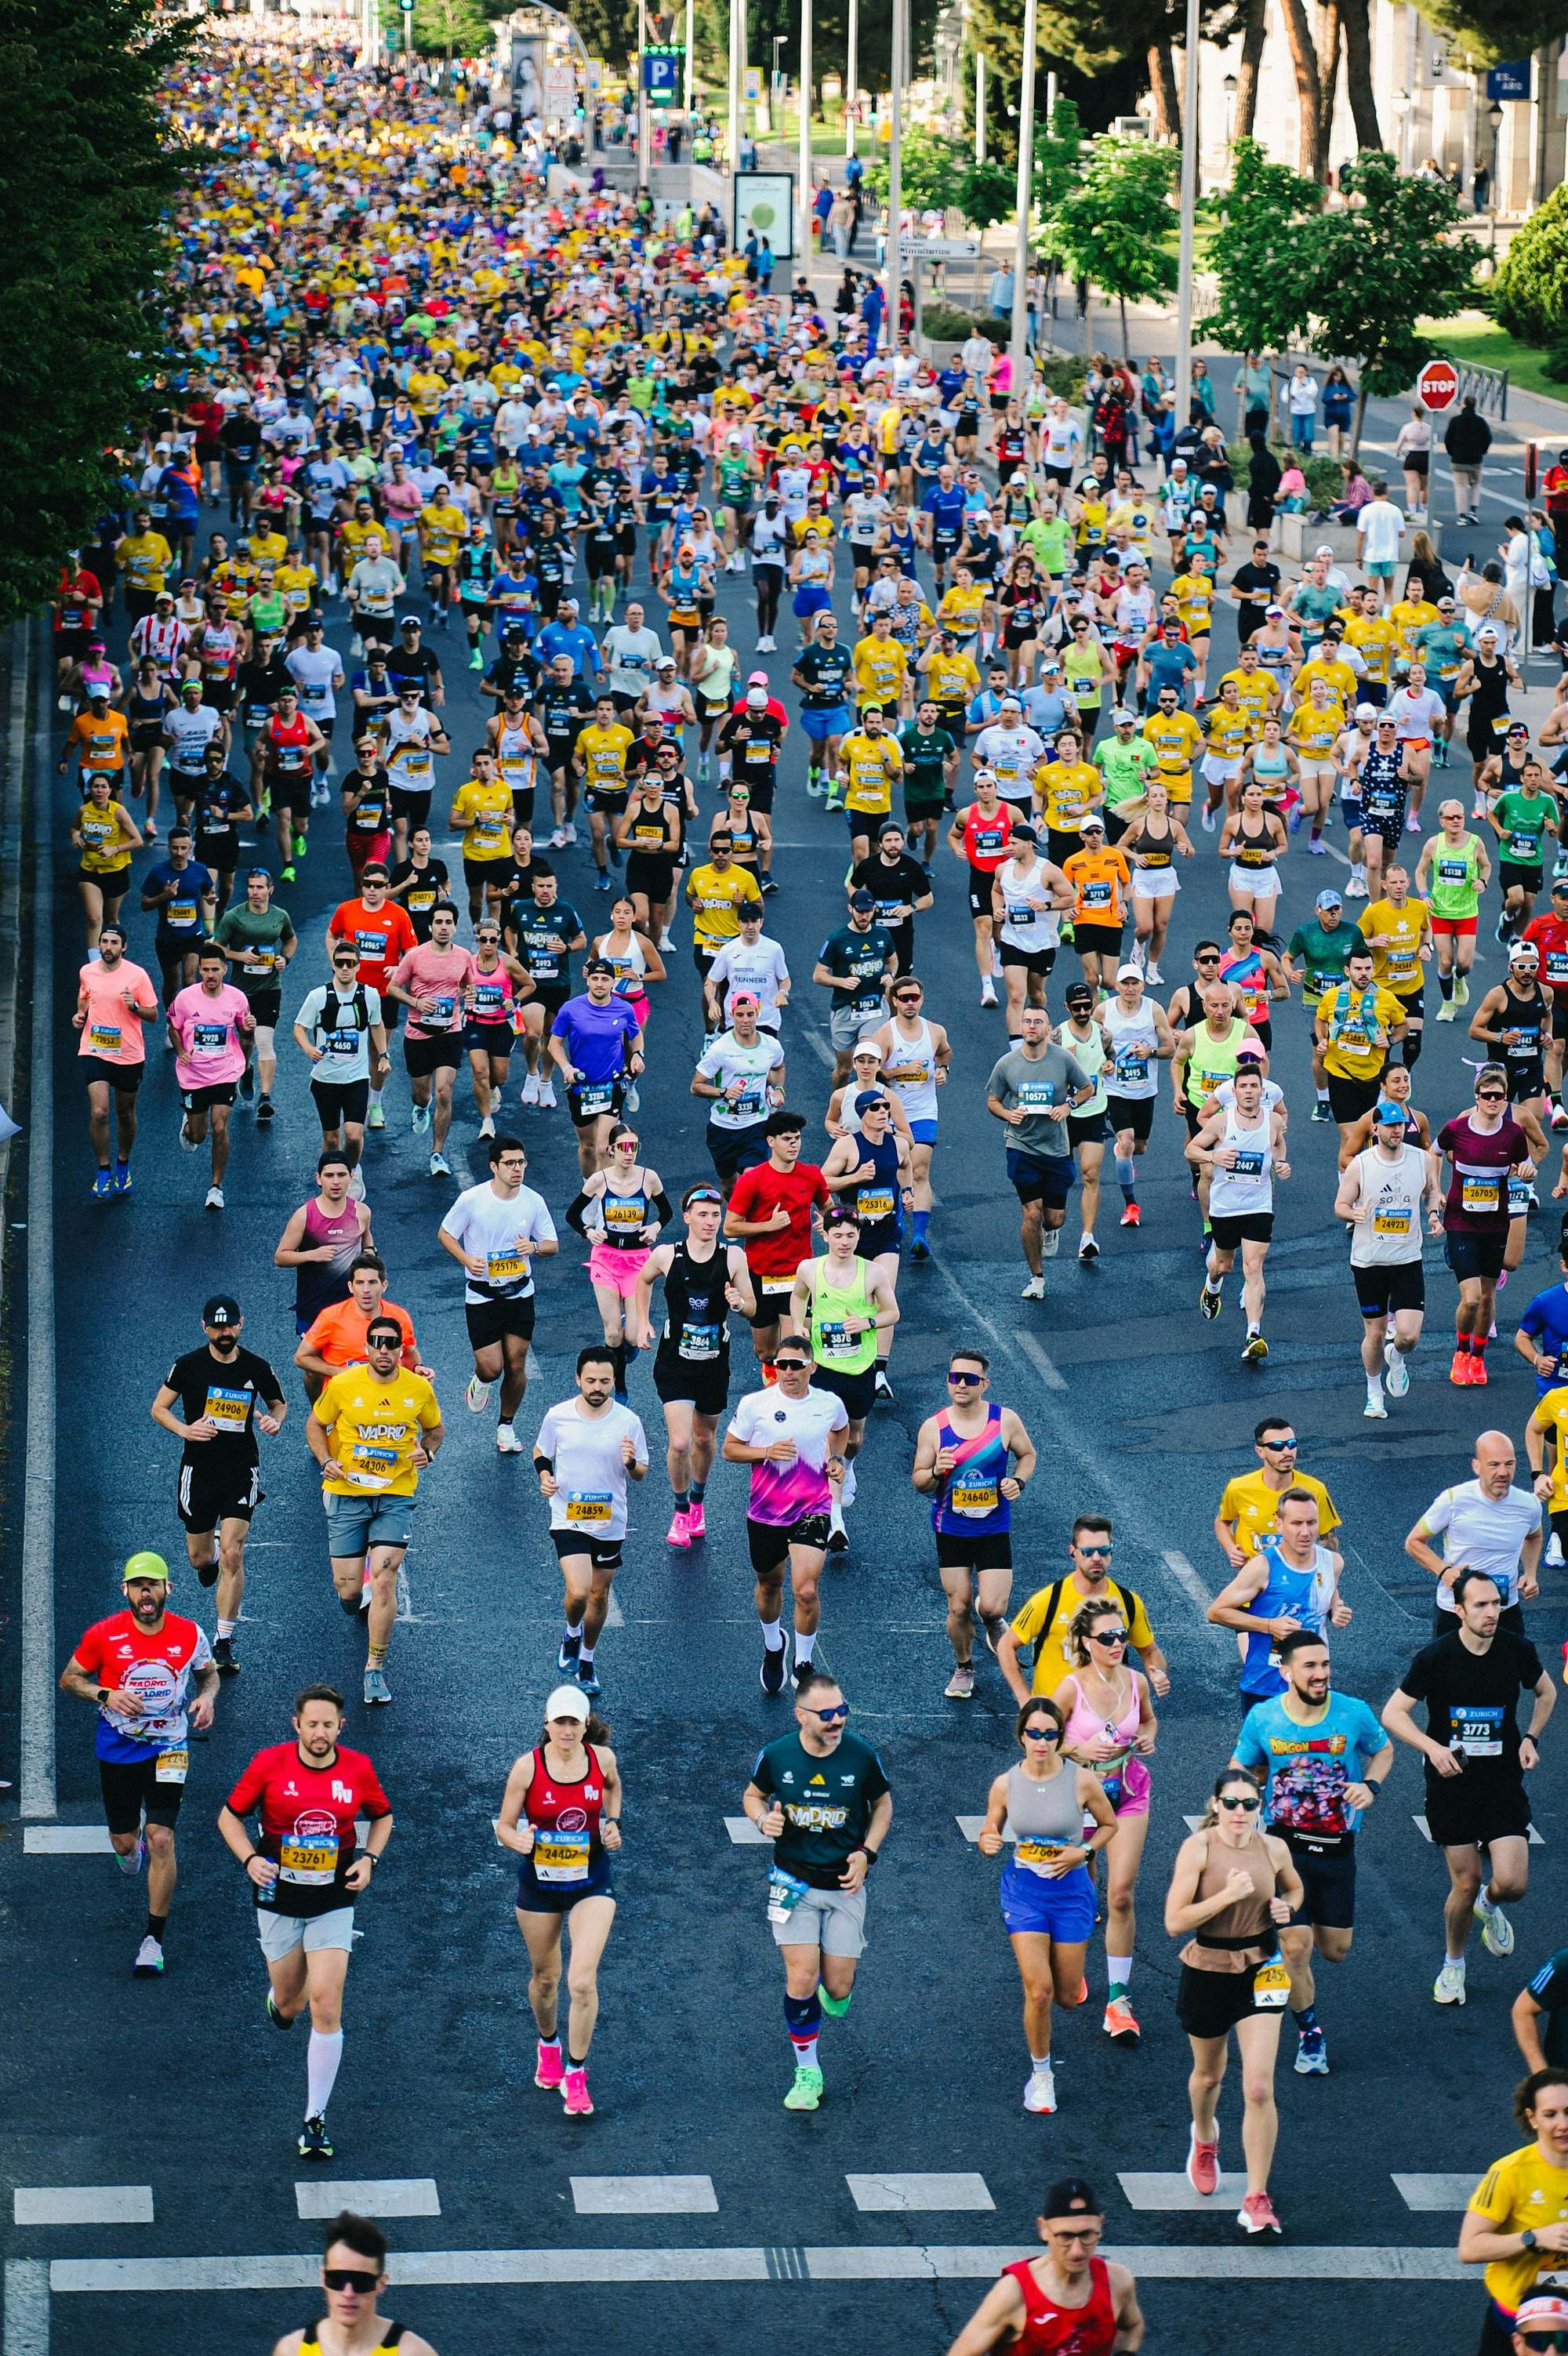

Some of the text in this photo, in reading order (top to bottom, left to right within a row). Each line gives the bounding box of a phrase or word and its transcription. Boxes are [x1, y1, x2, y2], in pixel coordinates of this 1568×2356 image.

[652, 61, 668, 85] P
[1422, 380, 1456, 394] STOP
[361, 941, 379, 949] 14965
[849, 961, 883, 977] MADRID
[859, 1000, 874, 1009] 1063
[202, 1034, 219, 1043] 2928
[334, 1041, 352, 1051] 4650
[1125, 1068, 1141, 1078] 3495
[1025, 1091, 1047, 1101] 10573
[1236, 1161, 1254, 1171] 2447
[866, 1200, 887, 1209] 25316
[614, 1210, 637, 1218] 26139
[1382, 1220, 1405, 1229] 24923
[496, 1261, 518, 1272] 25176
[690, 1335, 710, 1347] 3864
[224, 1392, 249, 1401] ZURICH
[215, 1402, 241, 1415] 24906
[356, 1424, 407, 1441] MADRID
[368, 1449, 395, 1459] ZURICH
[359, 1459, 387, 1472] 24306
[961, 1492, 989, 1503] 24640
[576, 1505, 604, 1516] 24859
[1463, 1723, 1490, 1736] 3773
[785, 1805, 847, 1828] MADRID
[303, 1839, 334, 1847] ZURICH
[292, 1851, 325, 1864] 23761
[545, 1849, 579, 1860] 24407
